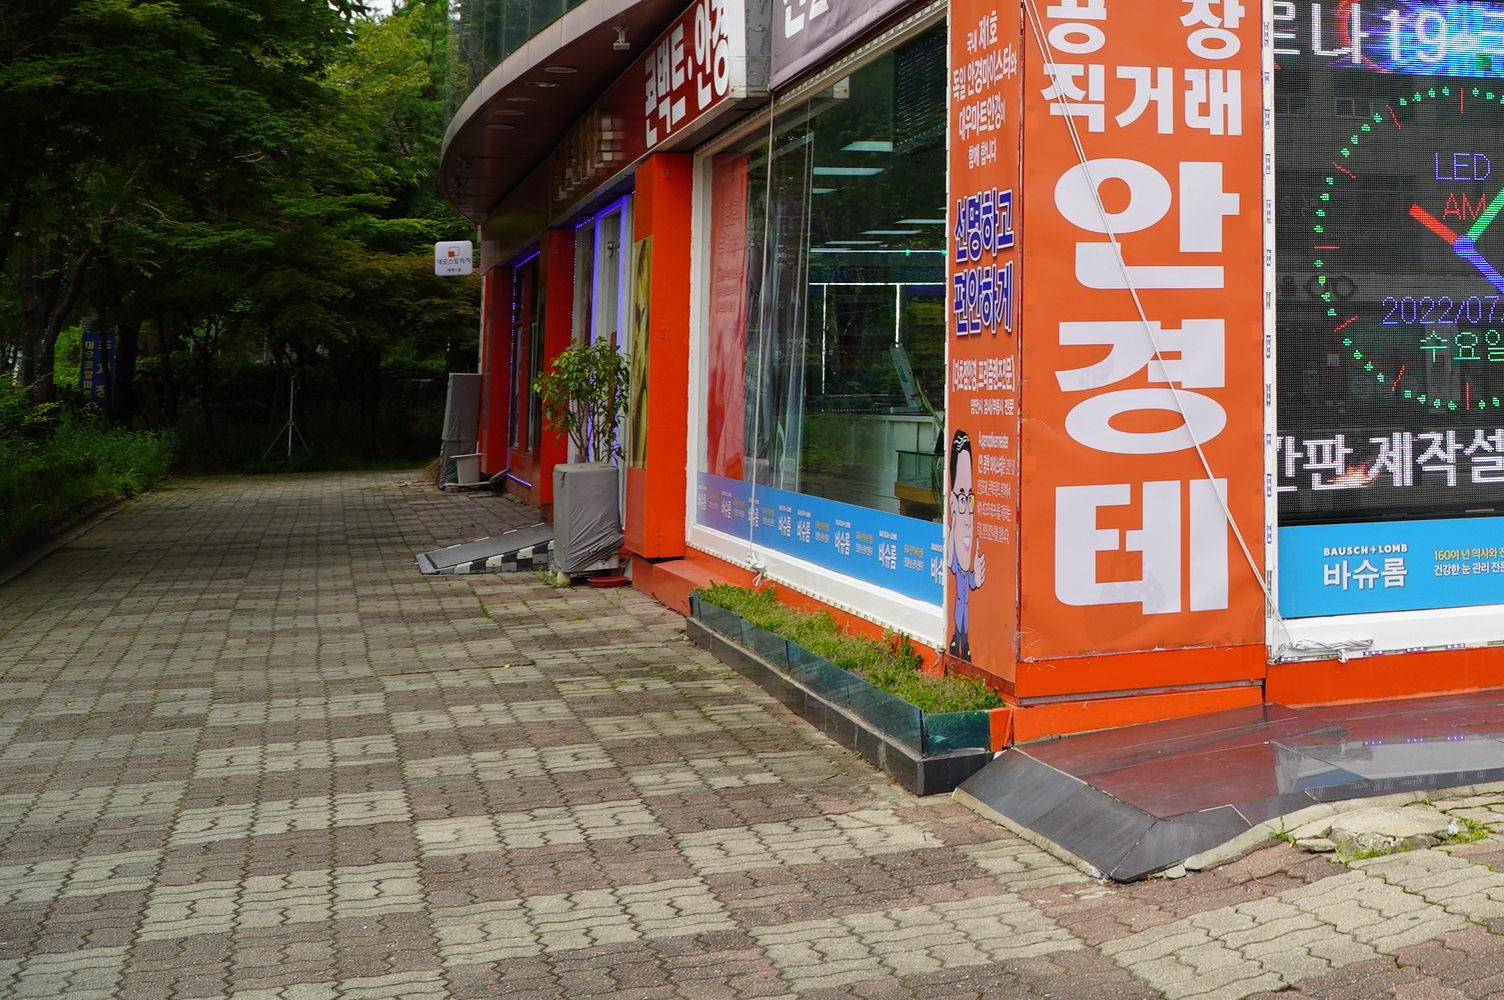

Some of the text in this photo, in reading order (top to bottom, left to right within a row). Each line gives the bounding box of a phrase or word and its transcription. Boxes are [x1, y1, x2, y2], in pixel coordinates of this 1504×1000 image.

[1040, 63, 1242, 136] 직거래
[1435, 152, 1491, 181] LED
[1442, 192, 1487, 221] AM
[953, 187, 1014, 263] 선명하고
[953, 260, 1013, 336] 편안하게
[1323, 543, 1409, 557] BAUSCH+LOMB
[1433, 550, 1460, 562] 160여
[1471, 547, 1499, 560] 역사와
[1322, 557, 1408, 592] 바슈롬
[1433, 563, 1461, 577] 건강한
[1462, 563, 1471, 576] 눈
[1472, 561, 1490, 575] 관리
